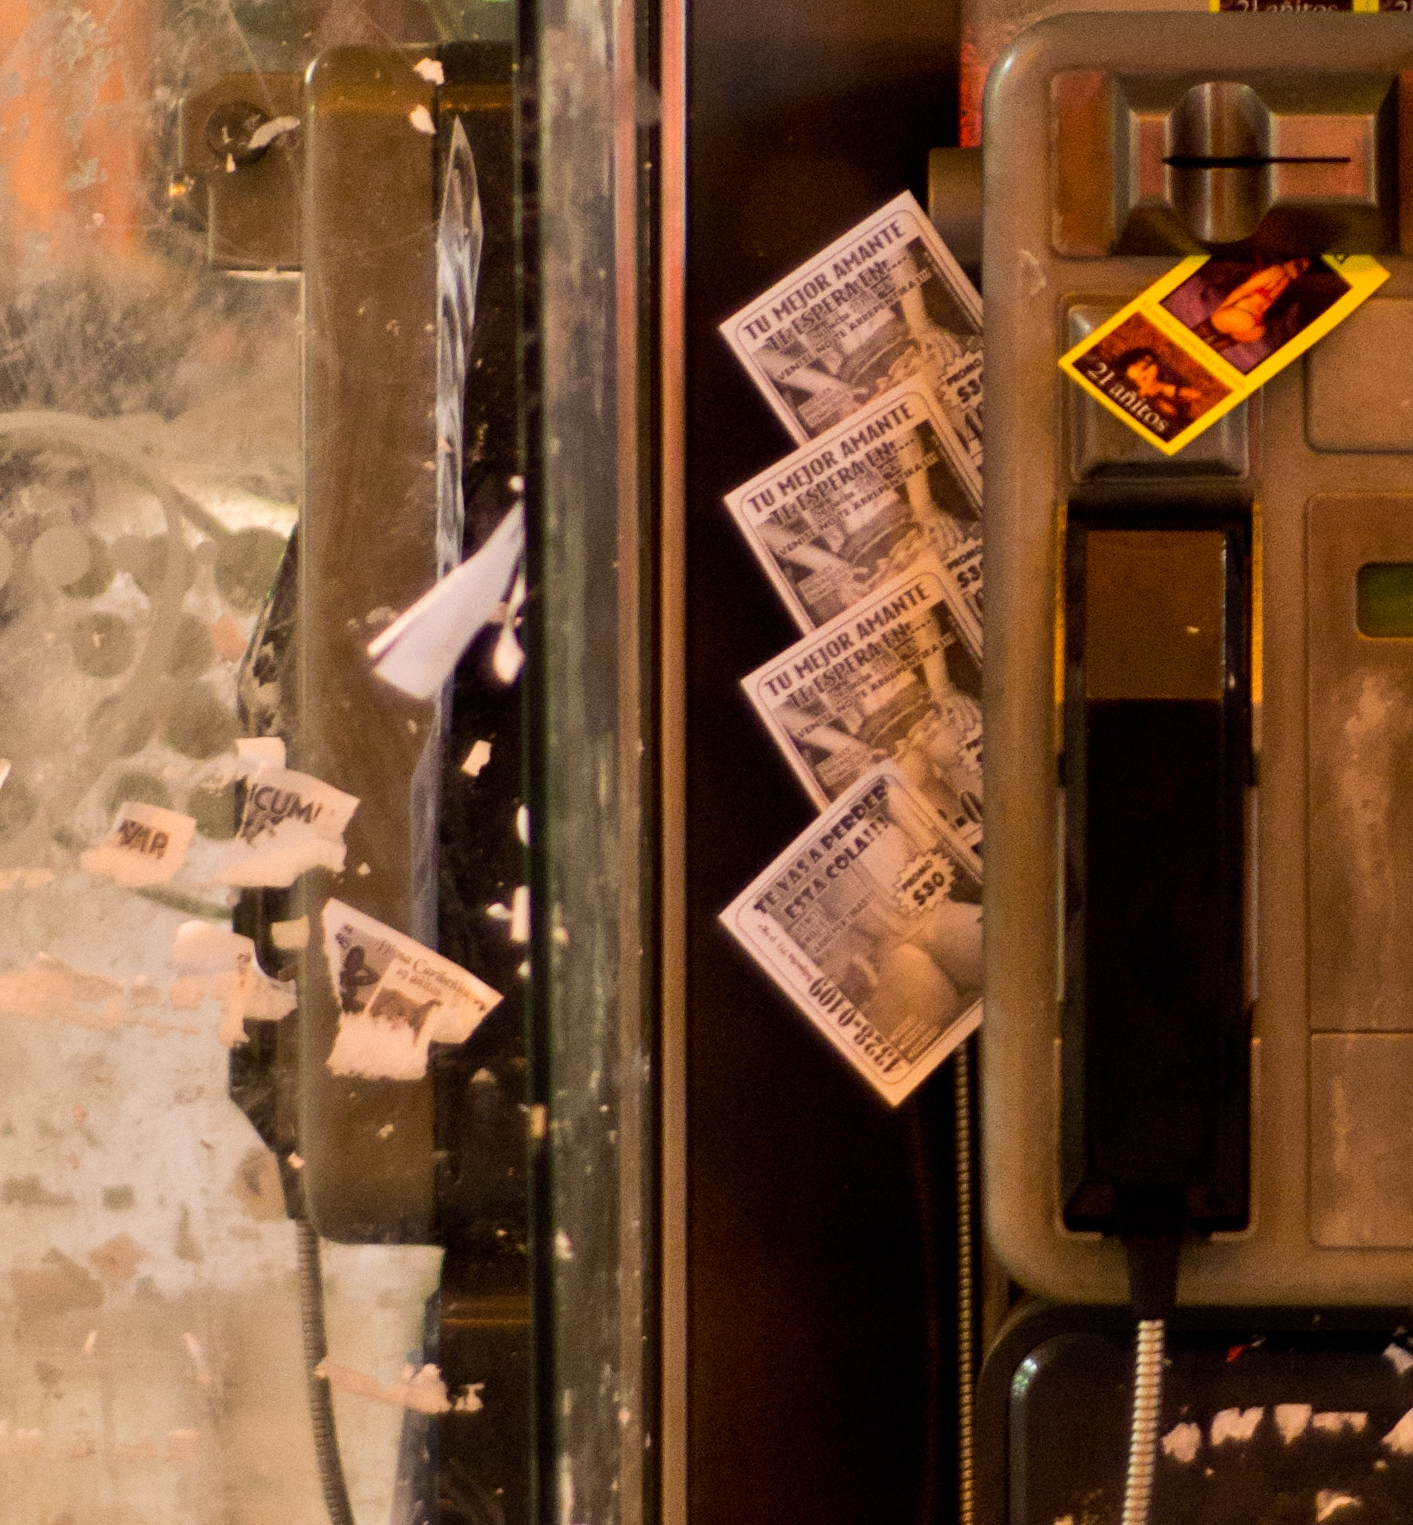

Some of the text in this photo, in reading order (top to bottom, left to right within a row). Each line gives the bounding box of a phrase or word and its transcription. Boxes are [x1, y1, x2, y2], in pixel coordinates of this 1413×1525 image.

[743, 220, 905, 341] TU MEJOR AMANTE
[790, 278, 860, 335] ESPERA
[945, 357, 983, 387] PROMO
[1086, 360, 1174, 434] 21 añitos
[747, 487, 776, 514] TU
[776, 448, 839, 498] MEJOR
[837, 401, 915, 458] AMANTE
[794, 457, 866, 511] ESPERA
[945, 543, 983, 571] PROMO
[954, 560, 984, 589] $3
[764, 670, 793, 697] TU
[792, 630, 855, 681] MEJOR
[852, 581, 930, 640] AMANTE
[811, 640, 881, 693] ESPERA
[753, 781, 889, 916] TE VAS A PERDER
[783, 875, 828, 920] ESTA
[822, 812, 890, 881] COLA!!!
[900, 859, 934, 891] PROMO
[806, 974, 902, 1074] 4328-0109
